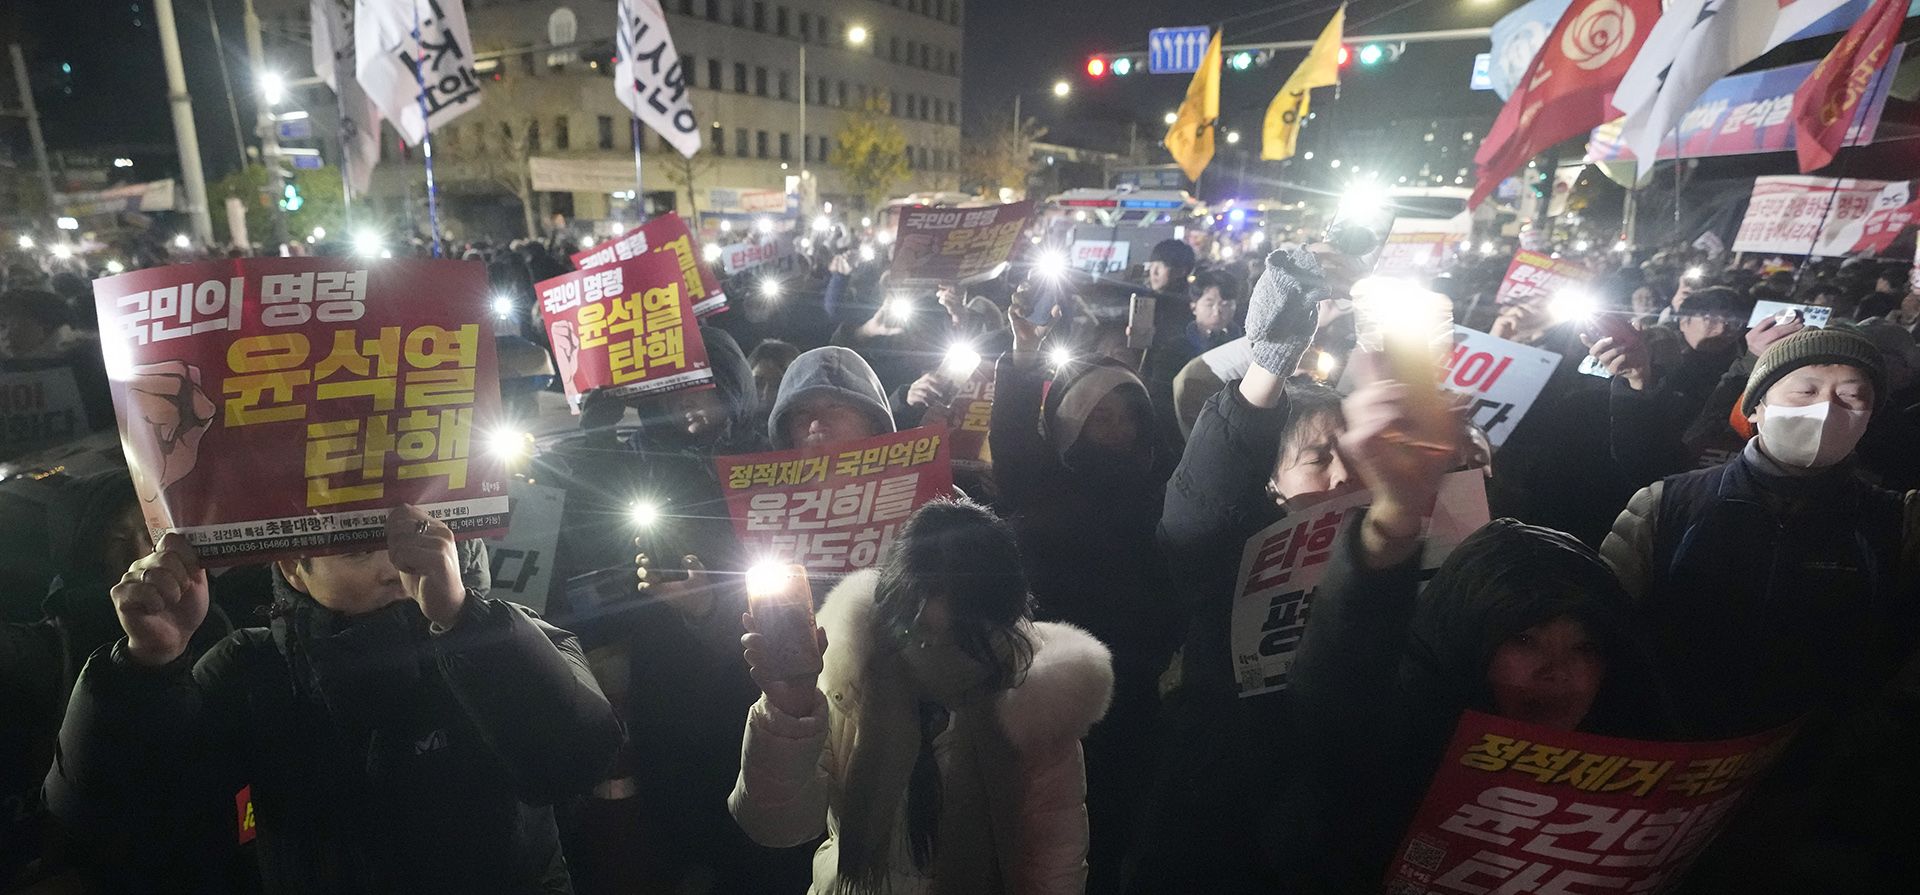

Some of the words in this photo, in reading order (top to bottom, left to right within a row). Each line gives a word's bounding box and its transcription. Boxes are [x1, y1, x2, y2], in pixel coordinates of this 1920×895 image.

[399, 0, 481, 117] 조합
[907, 212, 962, 229] 국민의
[113, 276, 245, 346] 국민의
[261, 270, 368, 327] 명령
[543, 280, 581, 313] 국민의
[583, 267, 624, 302] 명령
[578, 282, 682, 350] 윤석열
[223, 324, 480, 428] 윤석열
[608, 325, 685, 385] 탄핵
[304, 407, 473, 508] 탄핵
[729, 455, 830, 489] 정적제거
[835, 434, 941, 478] 국민억압
[746, 472, 920, 531] 윤건희를
[213, 528, 242, 541] 김건희
[770, 524, 900, 570] 타도하
[1459, 734, 1676, 796] 정적제거
